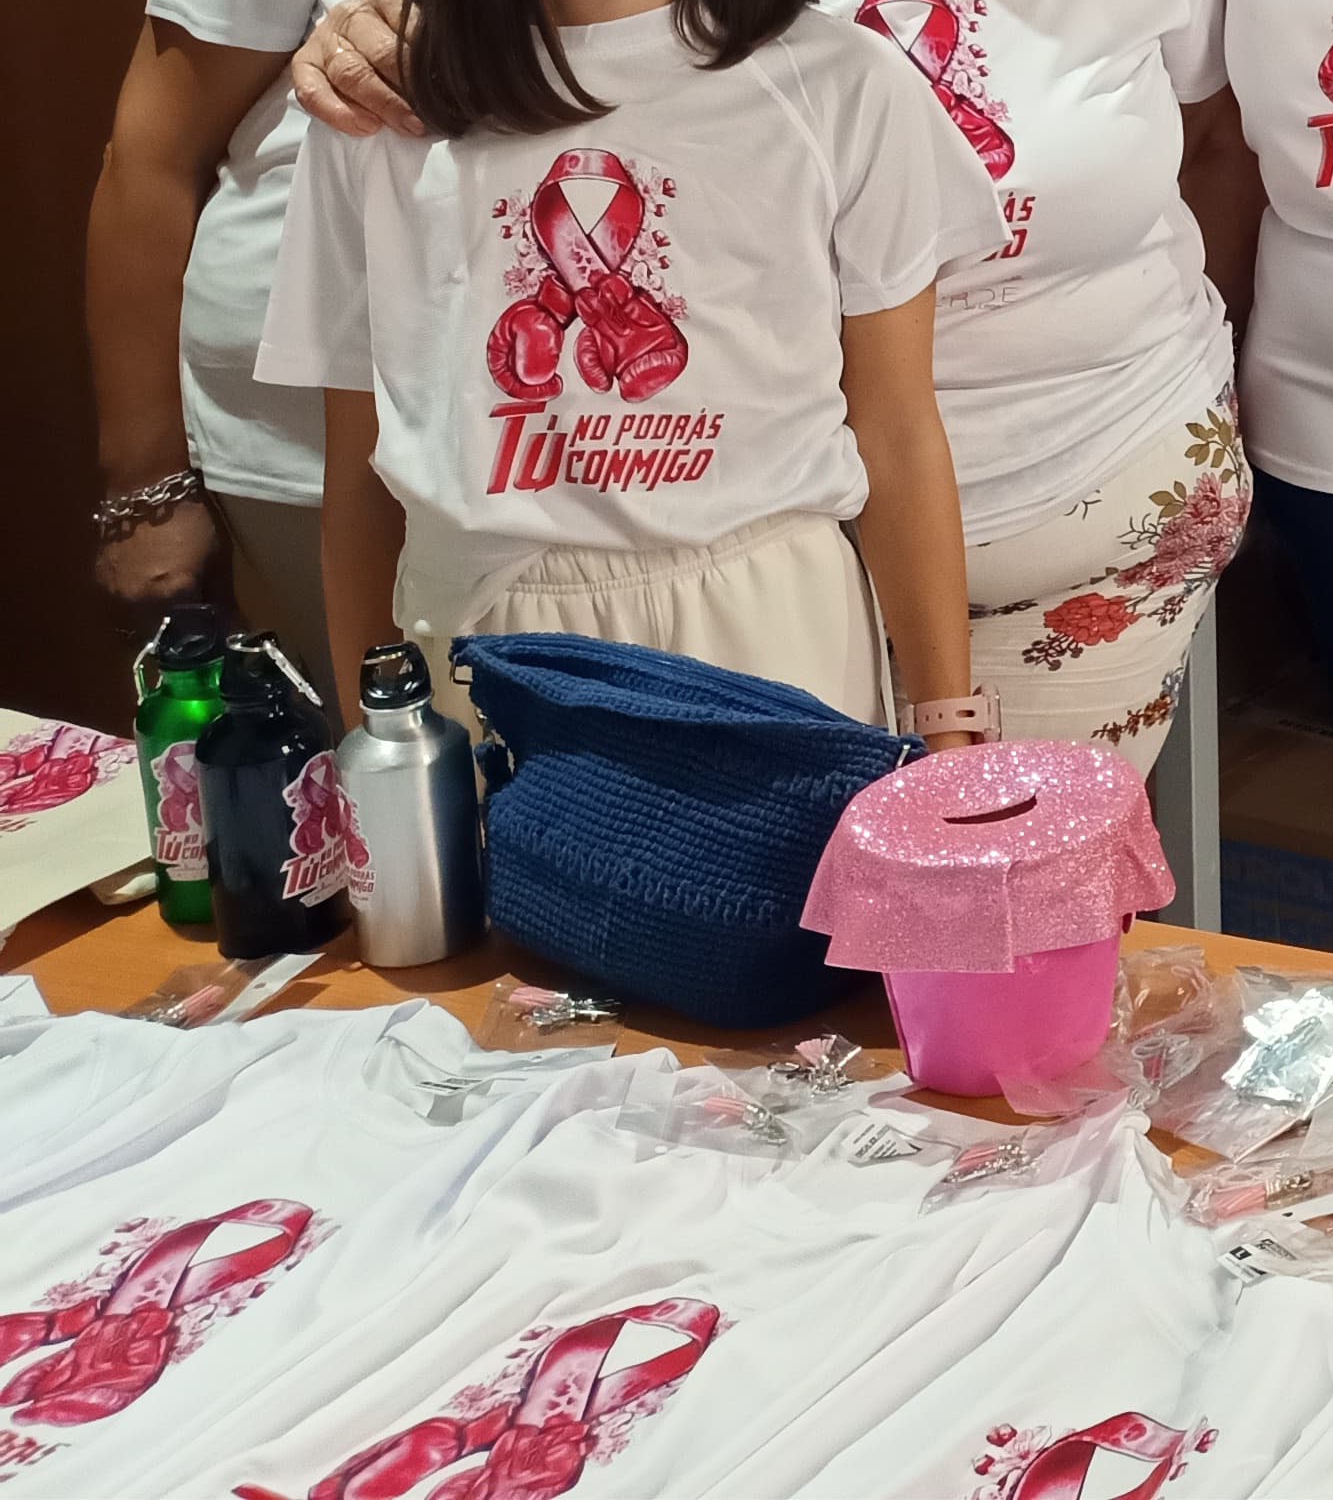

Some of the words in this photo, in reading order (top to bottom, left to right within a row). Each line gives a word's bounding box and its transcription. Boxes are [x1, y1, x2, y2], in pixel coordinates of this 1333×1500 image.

[569, 414, 611, 447] NO
[613, 408, 725, 446] PODRÁS
[565, 449, 714, 493] CONMIGO
